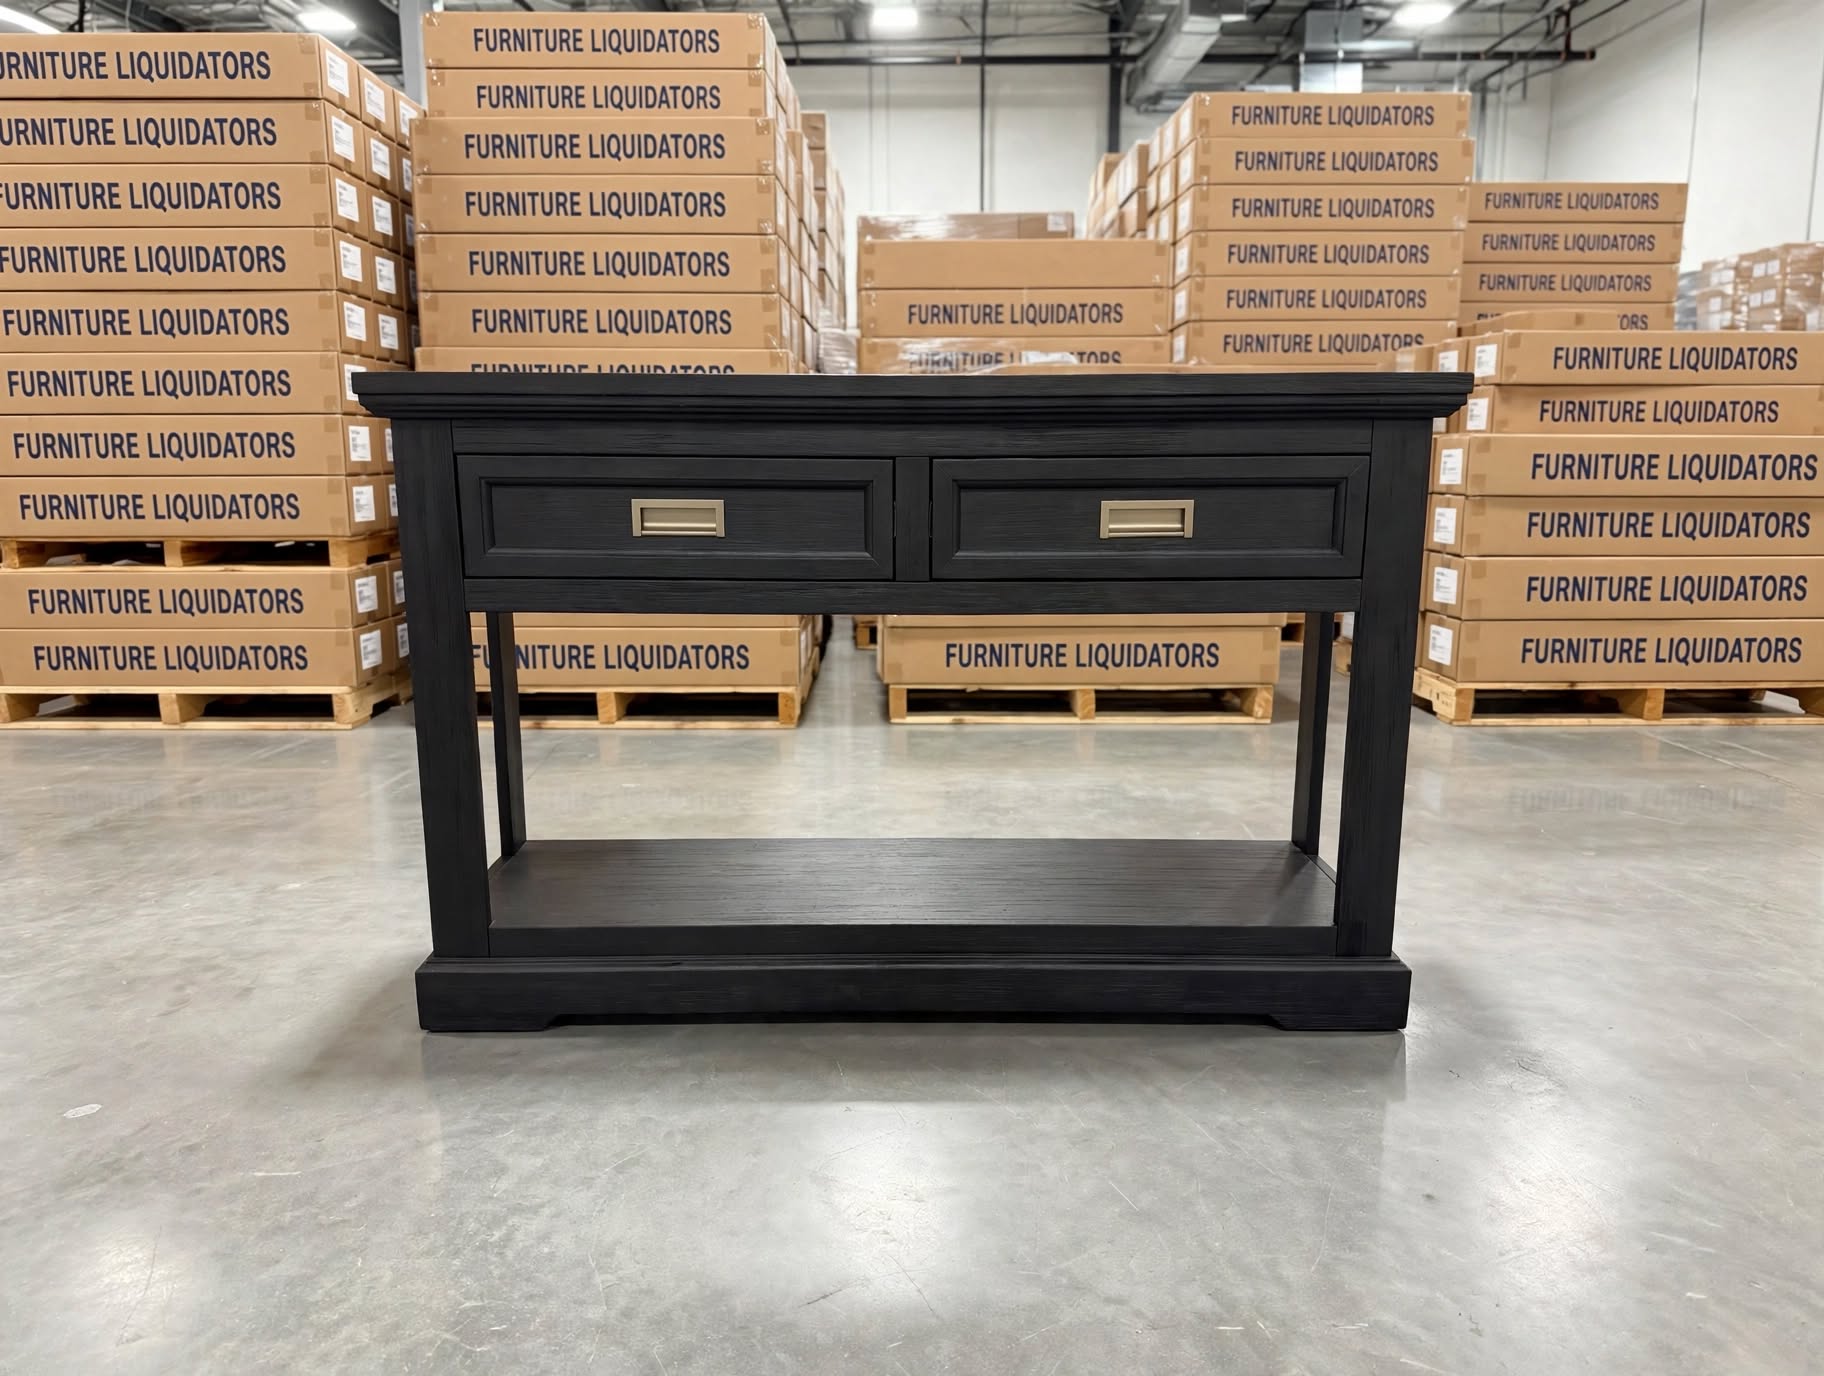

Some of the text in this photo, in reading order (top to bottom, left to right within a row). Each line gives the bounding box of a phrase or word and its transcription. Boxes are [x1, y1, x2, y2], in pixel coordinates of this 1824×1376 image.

[473, 28, 720, 54] FURNITURE LIQUIDATORS
[115, 50, 271, 83] LIQUIDATORS
[476, 84, 721, 112] FURNITURE LIQUIDATORS
[1231, 105, 1435, 128] FURNITURE LIQUIDATORS
[123, 117, 277, 148] LIQUIDATORS
[464, 133, 726, 161] FURNITURE LIQUIDATORS
[1235, 150, 1440, 174] FURNITURE LIQUIDATORS
[0, 181, 281, 211] URNITURE LIQUIDATORS
[465, 191, 726, 219] FURNITURE LIQUIDATORS
[1232, 197, 1436, 220] FURNITURE LIQUIDATORS
[1484, 192, 1660, 210] FURNITURE LIQUIDATORS
[1227, 243, 1431, 266] FURNITURE LIQUIDATORS
[1482, 233, 1655, 253] FURNITURE LIQUIDATORS
[0, 245, 286, 276] FURNITURE LIQUIDATORS
[468, 250, 730, 278] FURNITURE LIQUIDATORS
[1479, 274, 1652, 293] FURNITURE LIQUIDATORS
[1226, 288, 1426, 311] FURNITURE LIQUIDATORS
[2, 307, 290, 338] FURNITURE LIQUIDATORS
[471, 308, 732, 336] FURNITURE LIQUIDATORS
[908, 303, 1123, 326] FURNITURE LIQUIDATORS
[1223, 333, 1424, 353] FURNITURE LIQUIDATORS
[1553, 346, 1798, 372] FURNITURE LIQUIDATORS
[7, 369, 292, 400] FURNITURE LIQUIDATORS
[1539, 399, 1779, 424] FURNITURE LIQUIDATORS
[13, 431, 296, 461] FURNITURE LIQUIDATORS
[1531, 453, 1818, 482] FURNITURE LIQUIDATORS
[19, 493, 300, 522] FURNITURE LIQUIDATORS
[1527, 511, 1811, 541] FURNITURE LIQUIDATORS
[27, 587, 304, 617] FURNITURE LIQUIDATORS
[1526, 574, 1808, 604] FURNITURE LIQUIDATORS
[33, 644, 308, 673] FURNITURE LIQUIDATORS
[604, 644, 750, 673] LIQUIDATORS
[945, 642, 1220, 670] FURNITURE LIQUIDATORS
[1521, 636, 1802, 666] FURNITURE LIQUIDATORS
